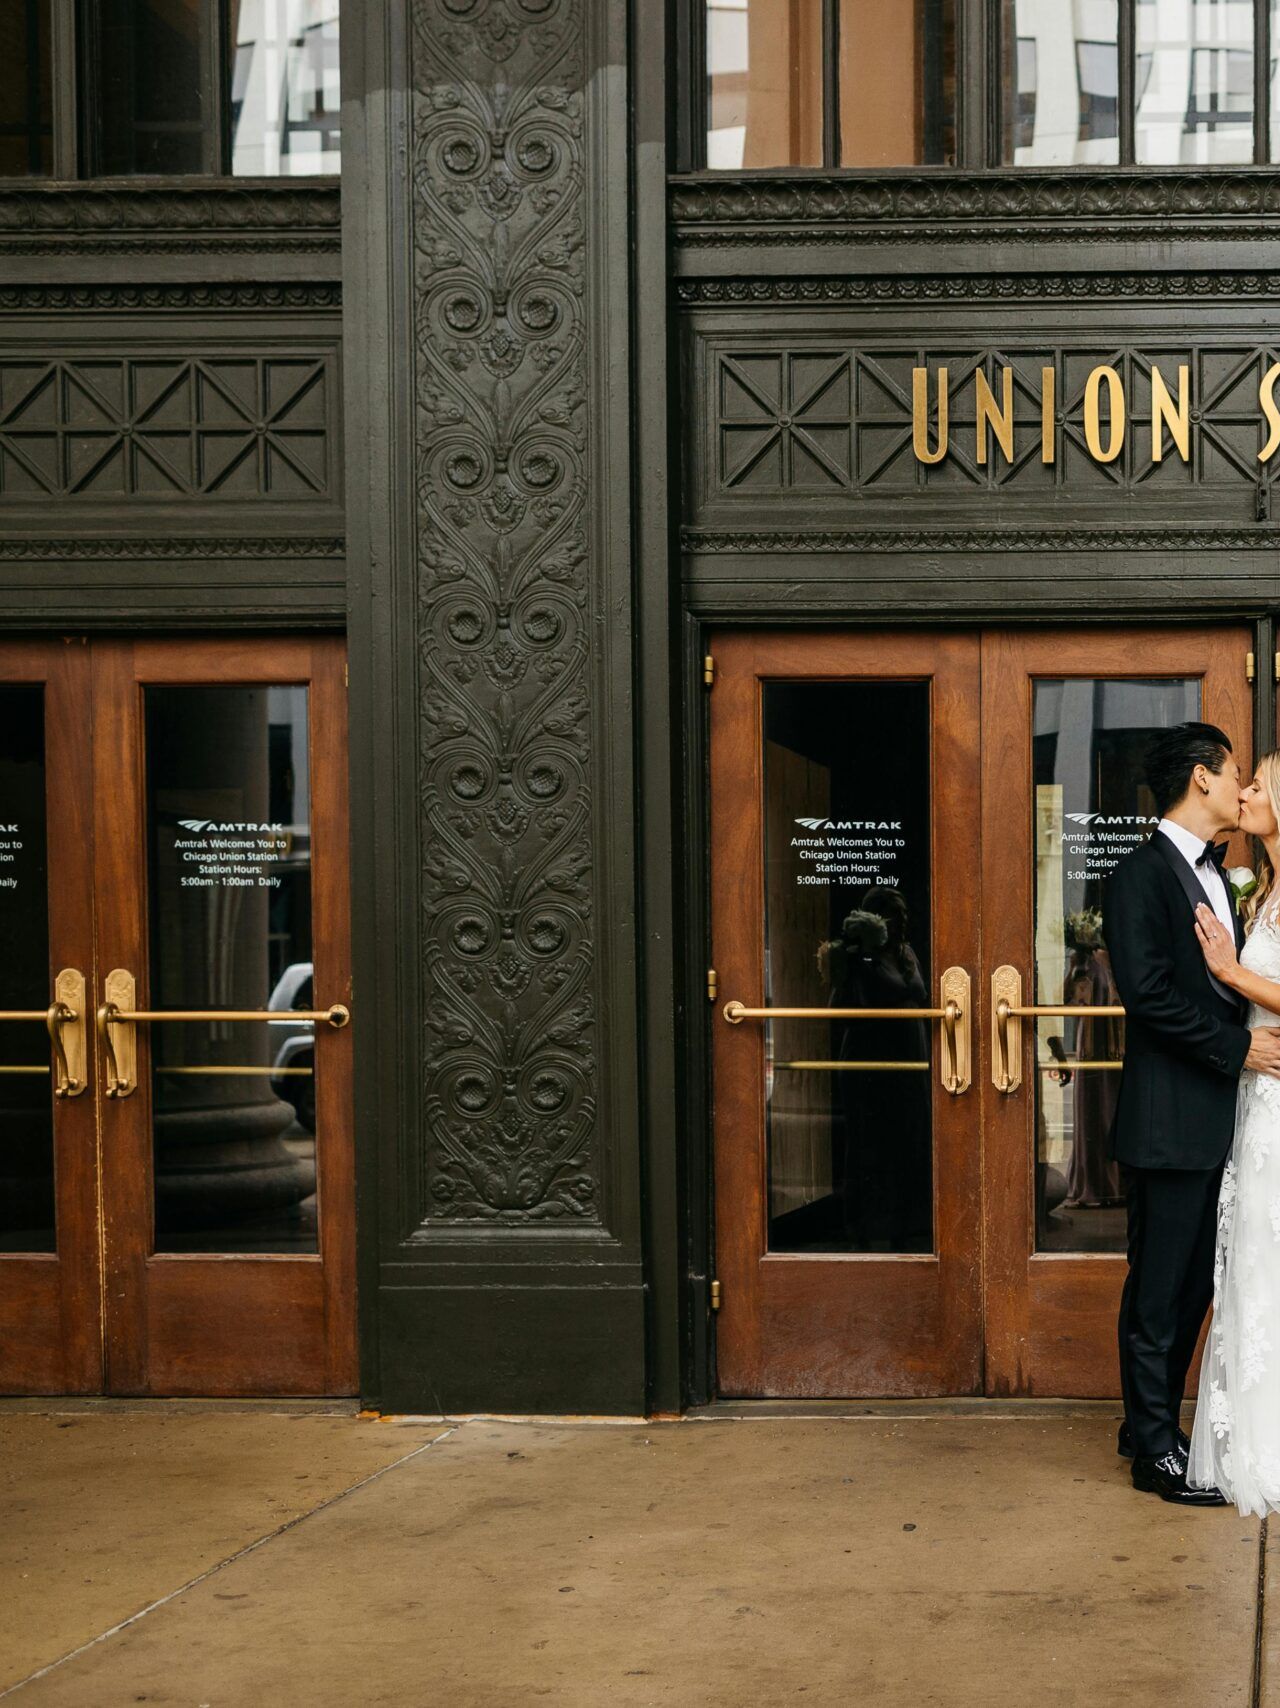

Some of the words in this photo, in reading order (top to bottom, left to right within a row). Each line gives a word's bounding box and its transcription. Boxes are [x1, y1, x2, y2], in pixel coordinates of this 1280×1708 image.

[912, 365, 1190, 464] UNION
[1094, 816, 1160, 824] AMTRA
[206, 823, 283, 831] AMTRAK
[1061, 833, 1096, 841] Amtrak
[1097, 833, 1144, 841] Welcomes
[12, 841, 23, 849] to
[174, 840, 208, 848] Amtrak
[210, 839, 255, 848] Welcomes
[257, 840, 274, 848] You
[791, 838, 825, 846] Amtrak
[827, 838, 873, 846] Welcomes
[875, 838, 893, 846] You
[1070, 846, 1105, 856] Chicago
[183, 852, 217, 862] Chicago
[220, 852, 246, 861] Union
[247, 852, 278, 861] Station
[800, 851, 834, 861] Chicago
[836, 851, 862, 859] Union
[865, 851, 896, 859] Station
[199, 865, 231, 874] Station
[234, 865, 262, 874] Hours:
[815, 863, 848, 872] Station
[851, 863, 880, 872] Hours:
[1067, 871, 1100, 880] 5:00am
[0, 877, 18, 888] aily
[181, 877, 213, 886] 5:00am
[222, 877, 254, 886] 1:00am
[258, 877, 281, 888] Daily
[797, 876, 830, 885] 5:00am
[838, 876, 871, 885] 1:00am
[876, 876, 899, 887] Daily
